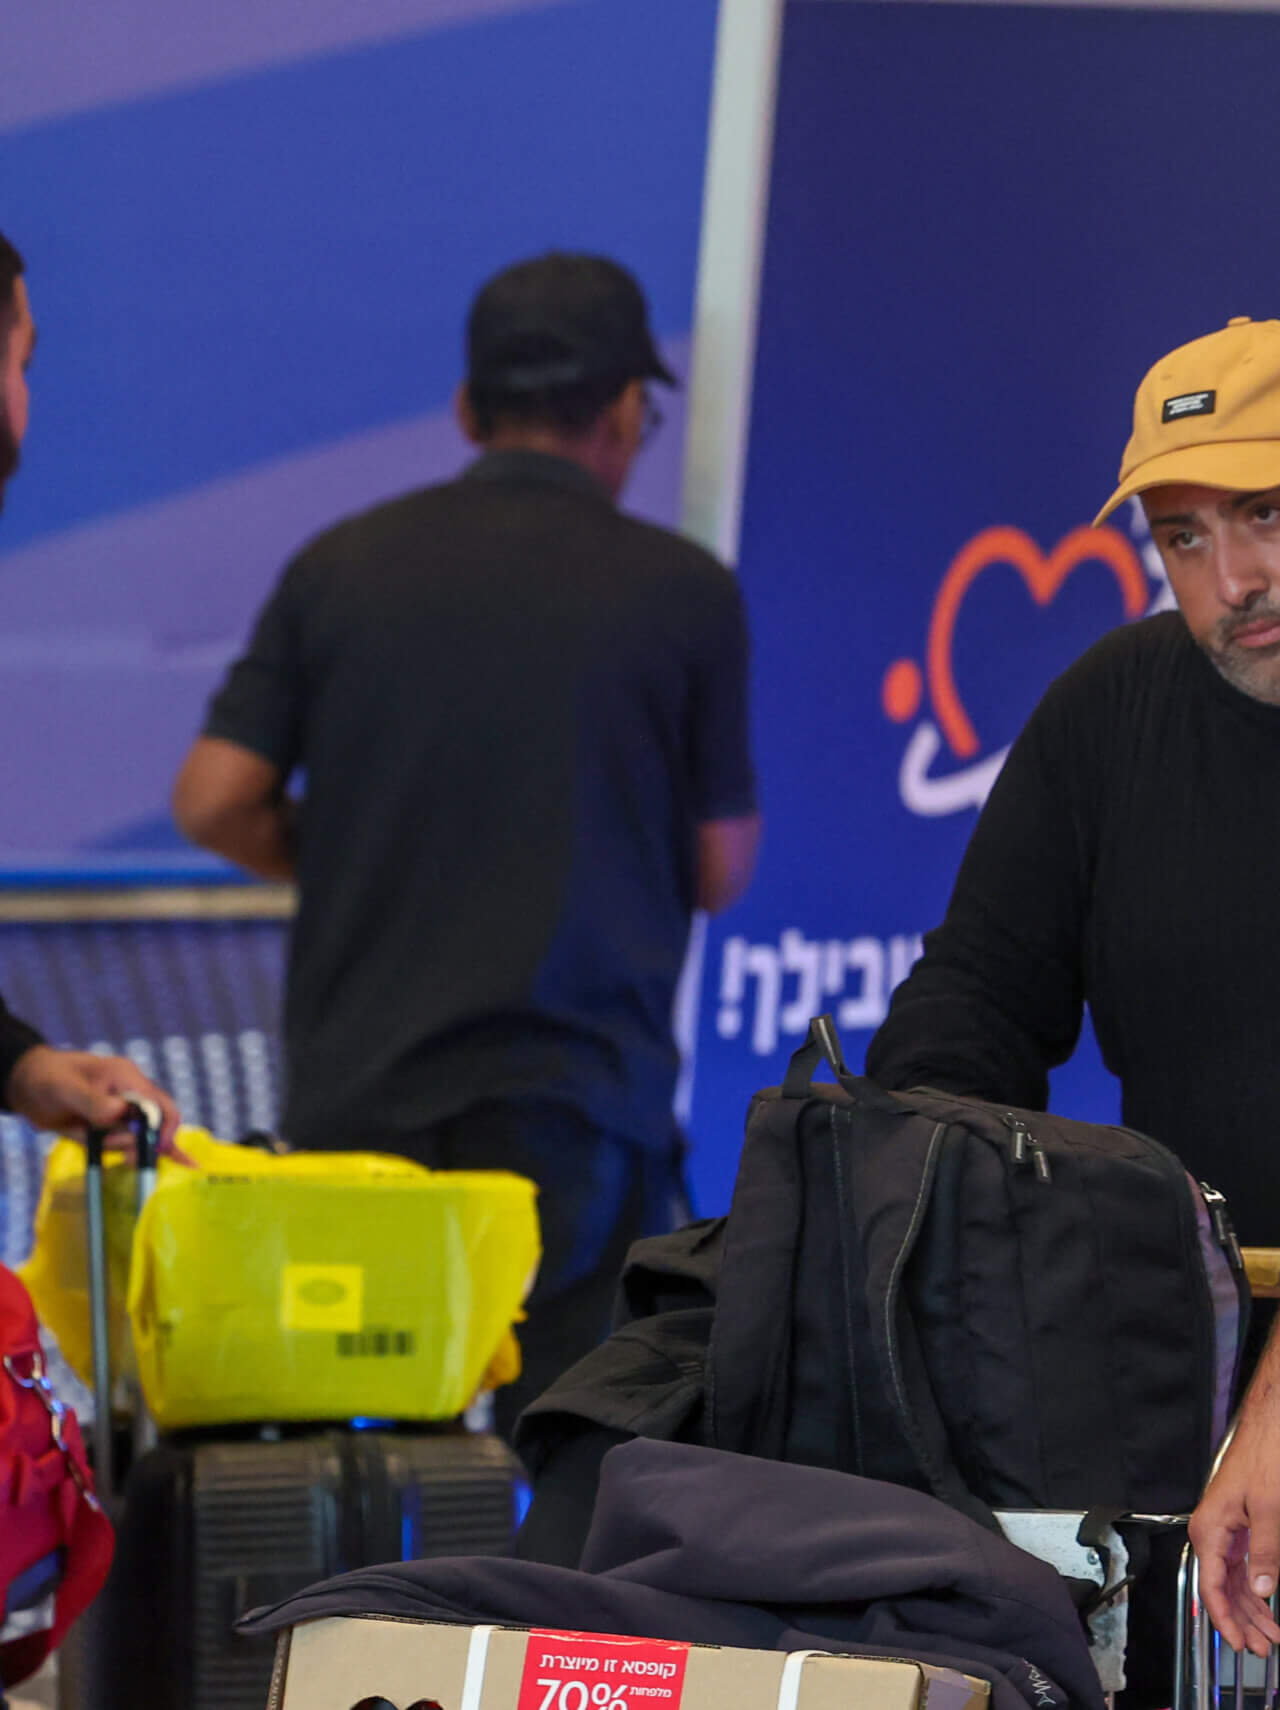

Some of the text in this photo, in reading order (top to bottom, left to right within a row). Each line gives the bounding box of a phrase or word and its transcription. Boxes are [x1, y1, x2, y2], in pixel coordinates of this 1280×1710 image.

[717, 927, 924, 1056] בילך!
[539, 1654, 677, 1679] קופסא זו מיוצרת
[536, 1678, 673, 1710] מלפחות 70%
